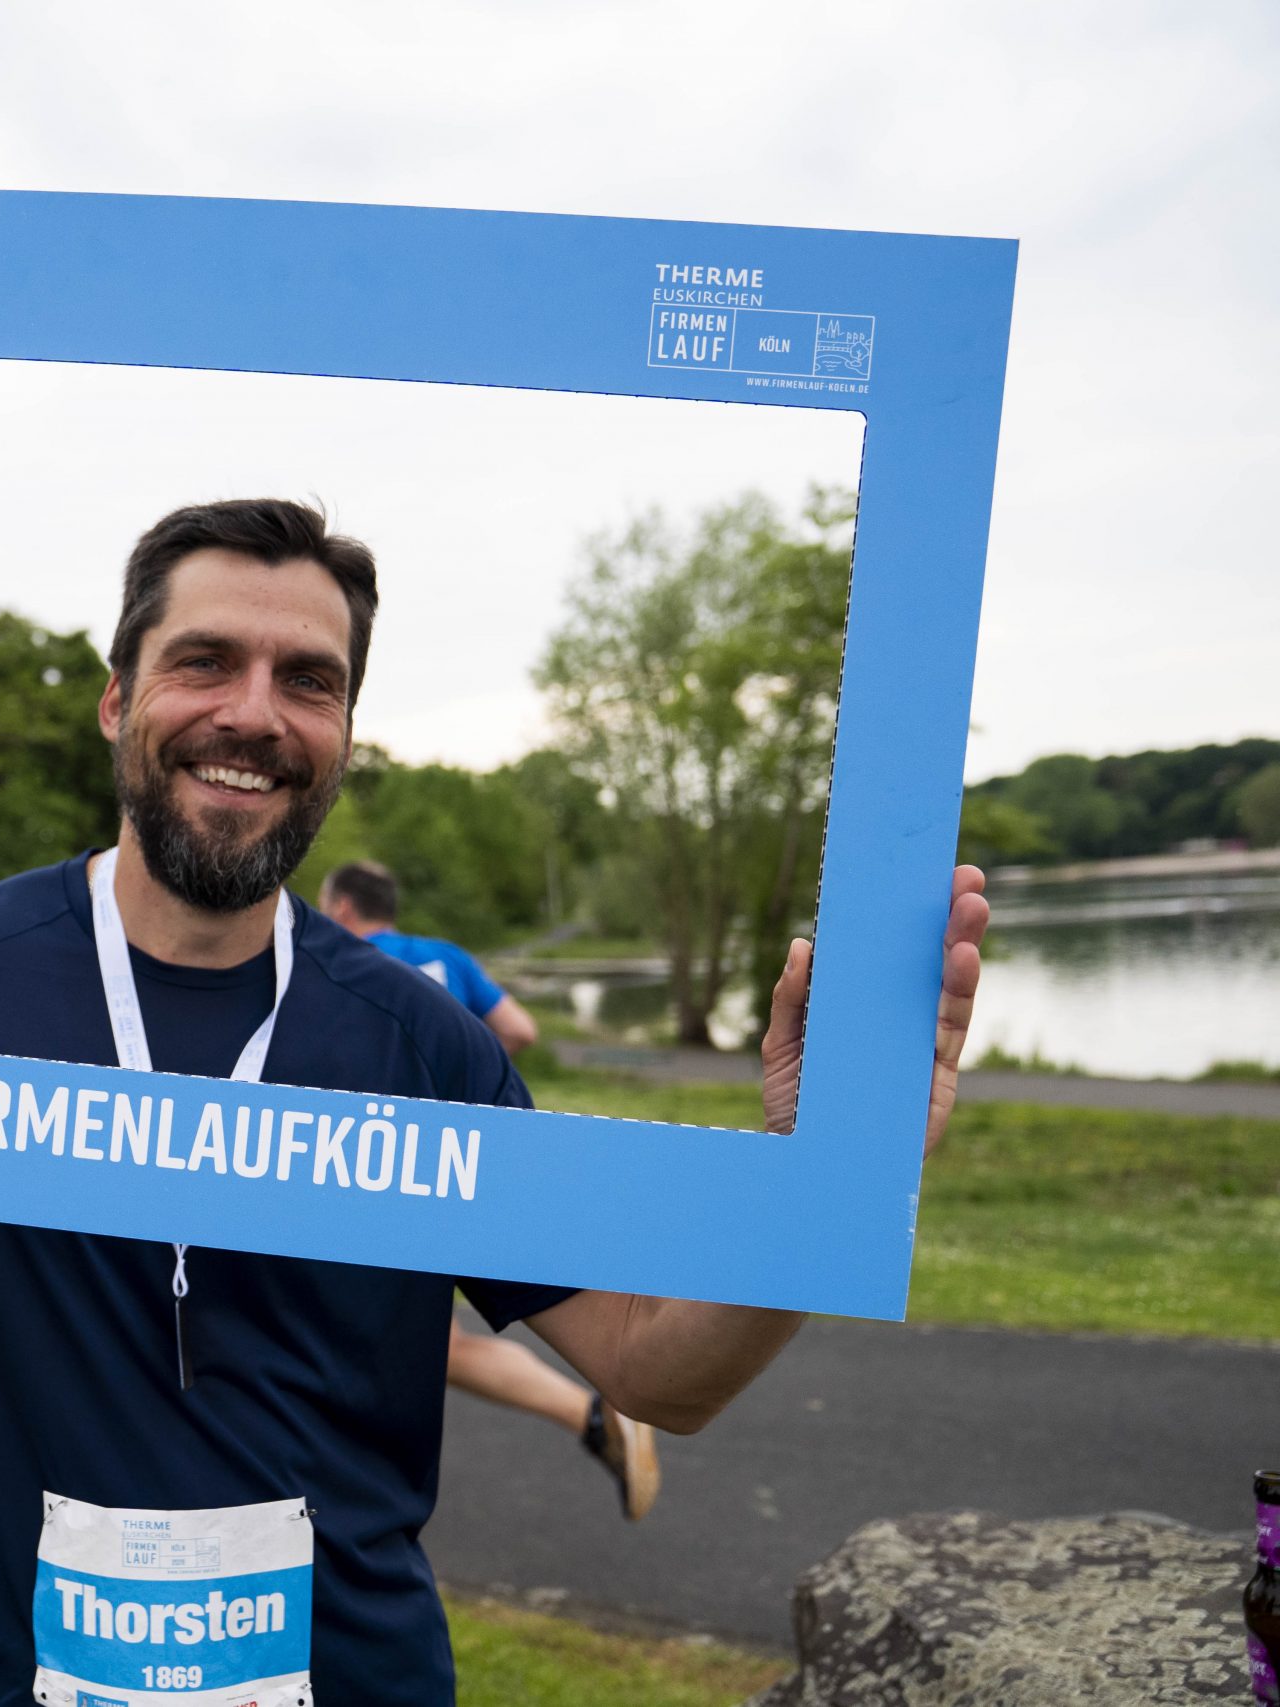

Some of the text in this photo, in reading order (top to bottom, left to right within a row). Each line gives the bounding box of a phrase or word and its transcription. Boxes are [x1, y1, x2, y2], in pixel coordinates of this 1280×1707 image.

[656, 263, 764, 288] THERME
[653, 288, 763, 307] EUSKIRCHEN
[660, 311, 728, 332] FIRMEN
[657, 333, 726, 362] LAUF
[759, 336, 791, 353] KÖLN
[746, 377, 870, 394] WWW.FIRMENLAUF-KOELN.DE
[123, 1520, 171, 1530] THERME
[126, 1542, 156, 1551] FIRMEN
[126, 1553, 157, 1565] LAUF
[54, 1577, 285, 1645] Thorsten
[141, 1665, 203, 1689] 1869
